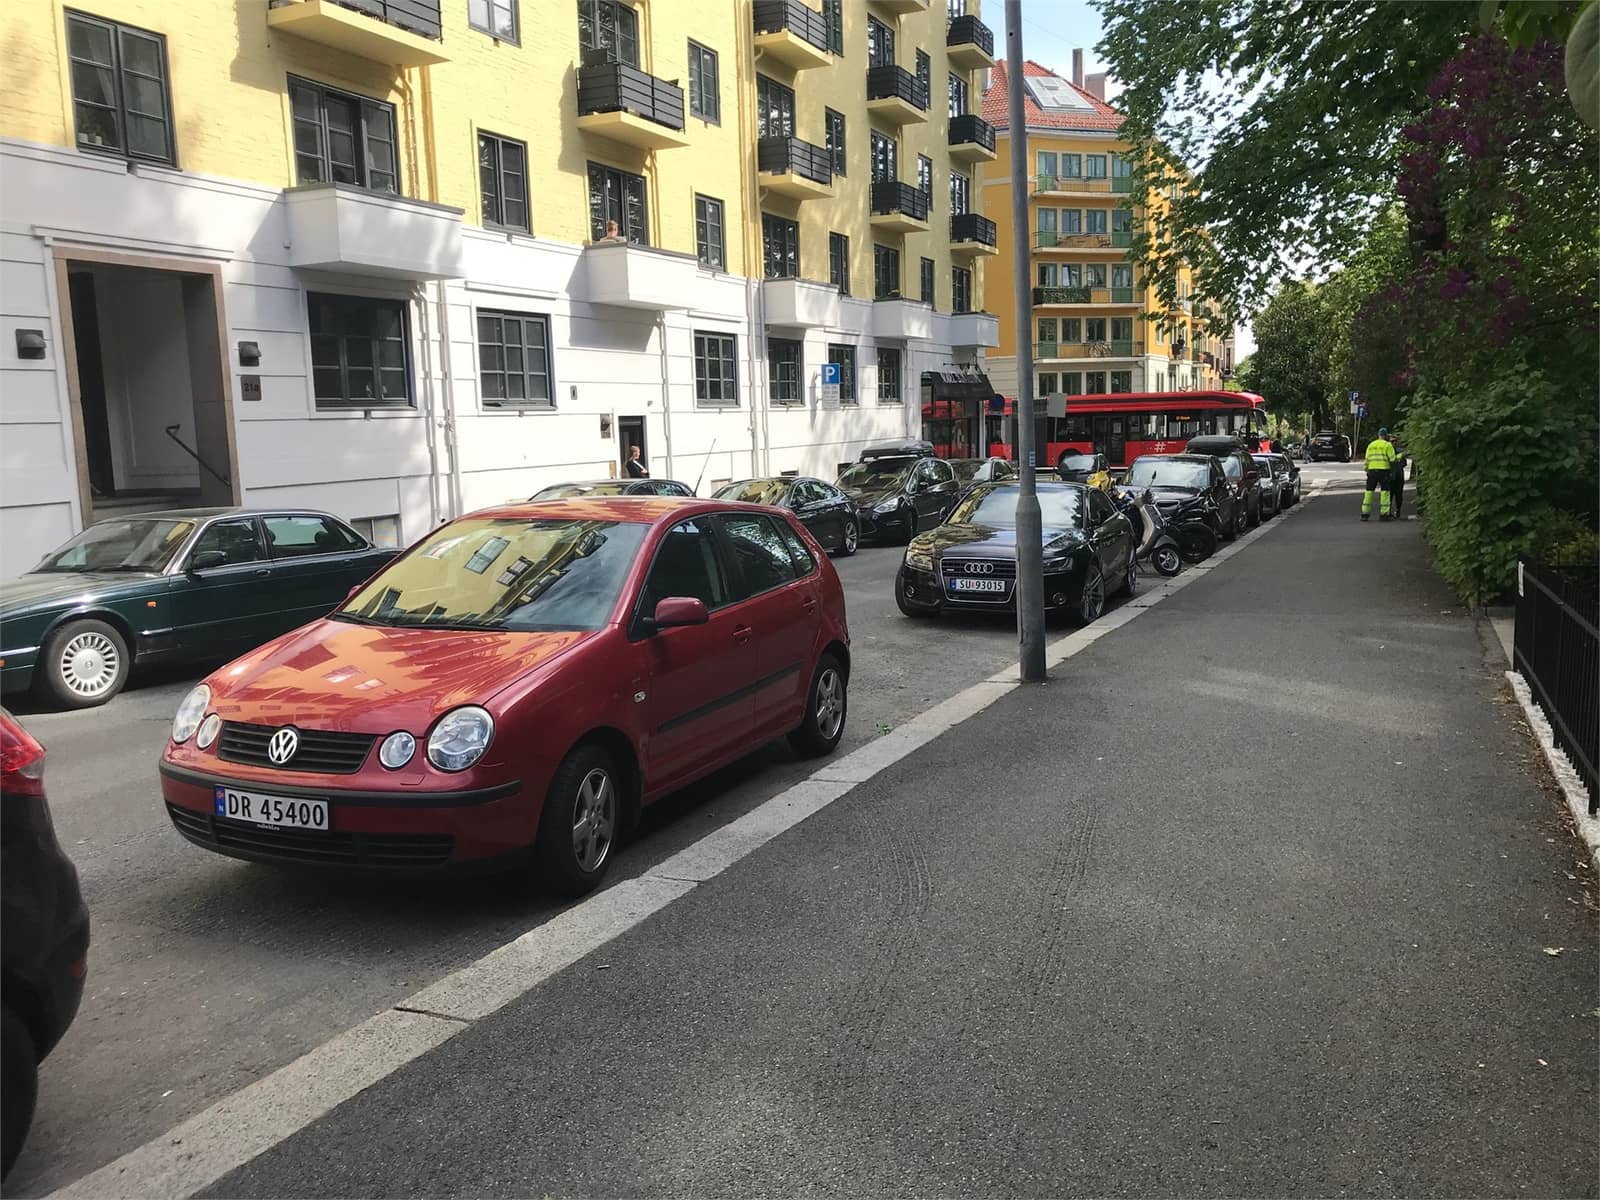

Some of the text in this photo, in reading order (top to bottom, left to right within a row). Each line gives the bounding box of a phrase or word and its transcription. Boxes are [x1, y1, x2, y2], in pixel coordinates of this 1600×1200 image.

[826, 366, 836, 383] P
[1353, 392, 1359, 401] P
[960, 579, 1003, 591] SU 93015
[228, 793, 325, 827] DR 45400
